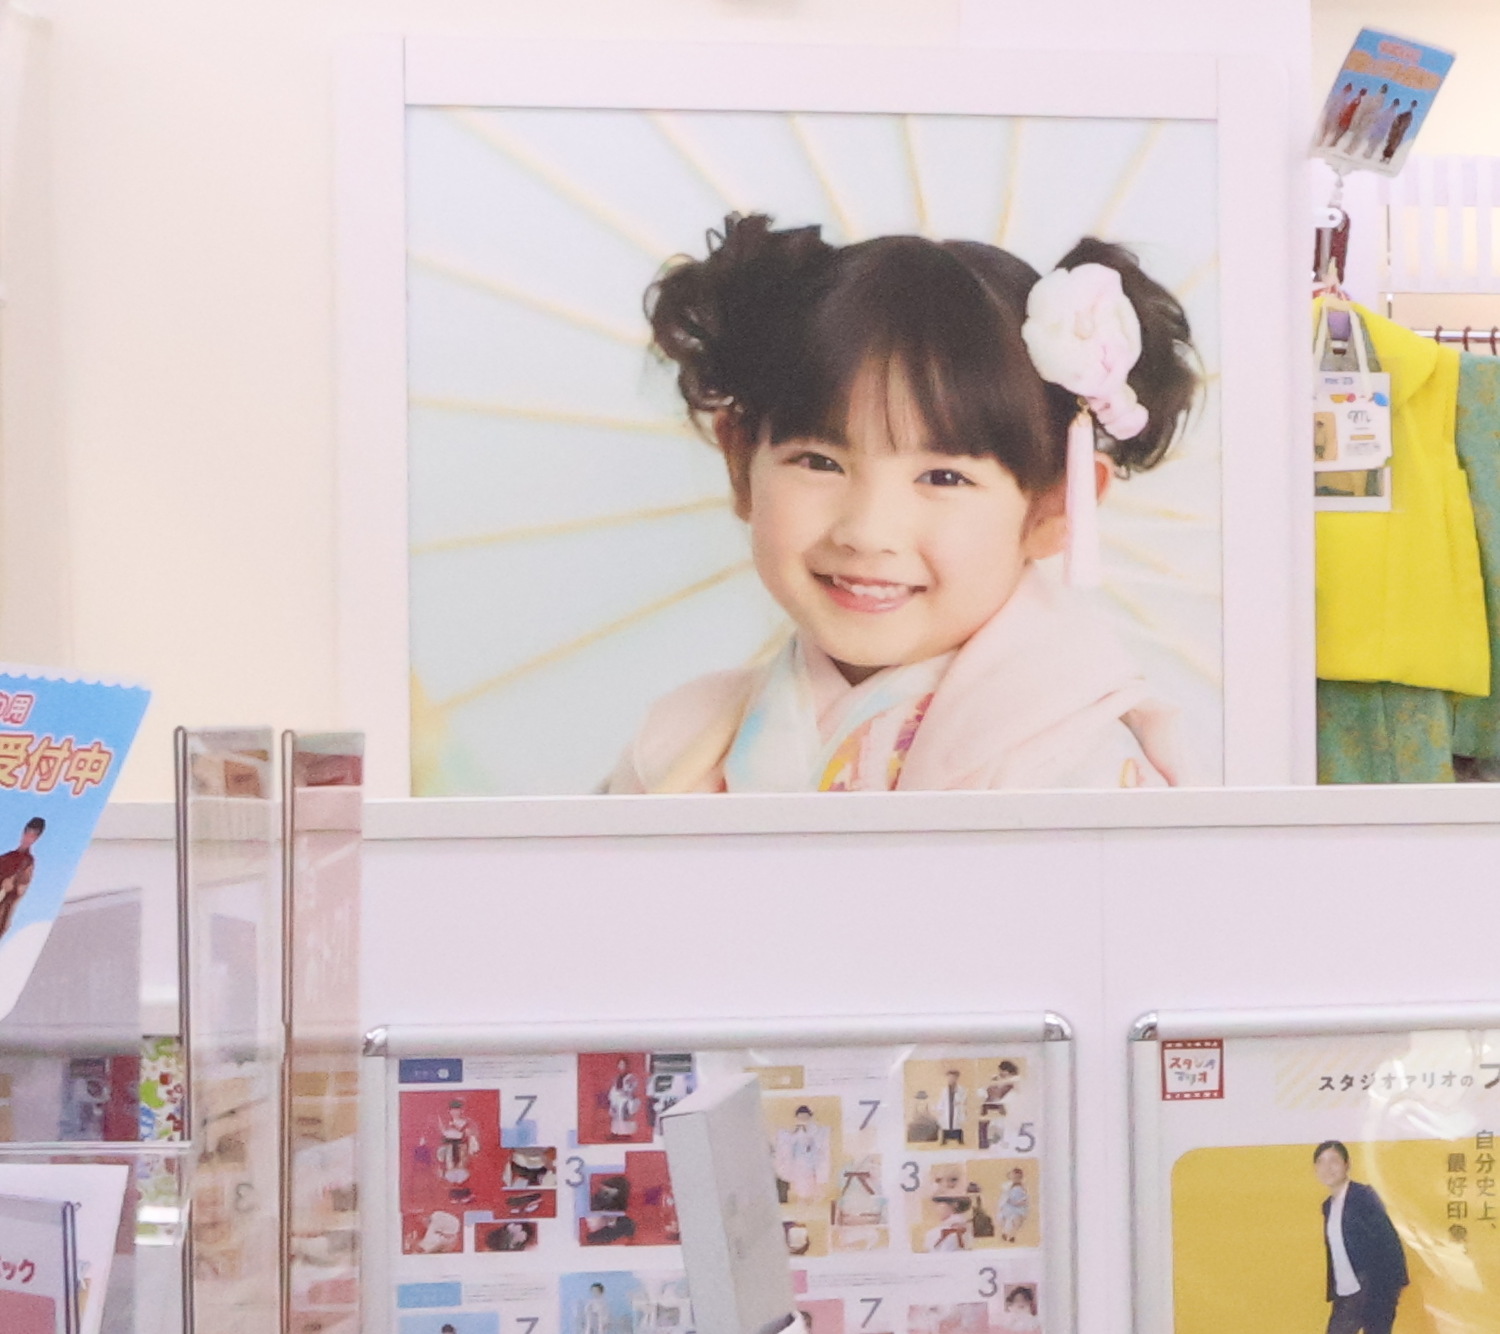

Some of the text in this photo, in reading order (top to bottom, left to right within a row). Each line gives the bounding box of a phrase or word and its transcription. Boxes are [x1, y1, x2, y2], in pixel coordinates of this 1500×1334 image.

[515, 1094, 538, 1125] 7
[858, 1099, 882, 1130] 7
[1013, 1123, 1036, 1154] 5
[564, 1155, 586, 1187] 3
[899, 1161, 920, 1193] 3
[976, 1266, 998, 1298] 3
[860, 1297, 883, 1328] 7
